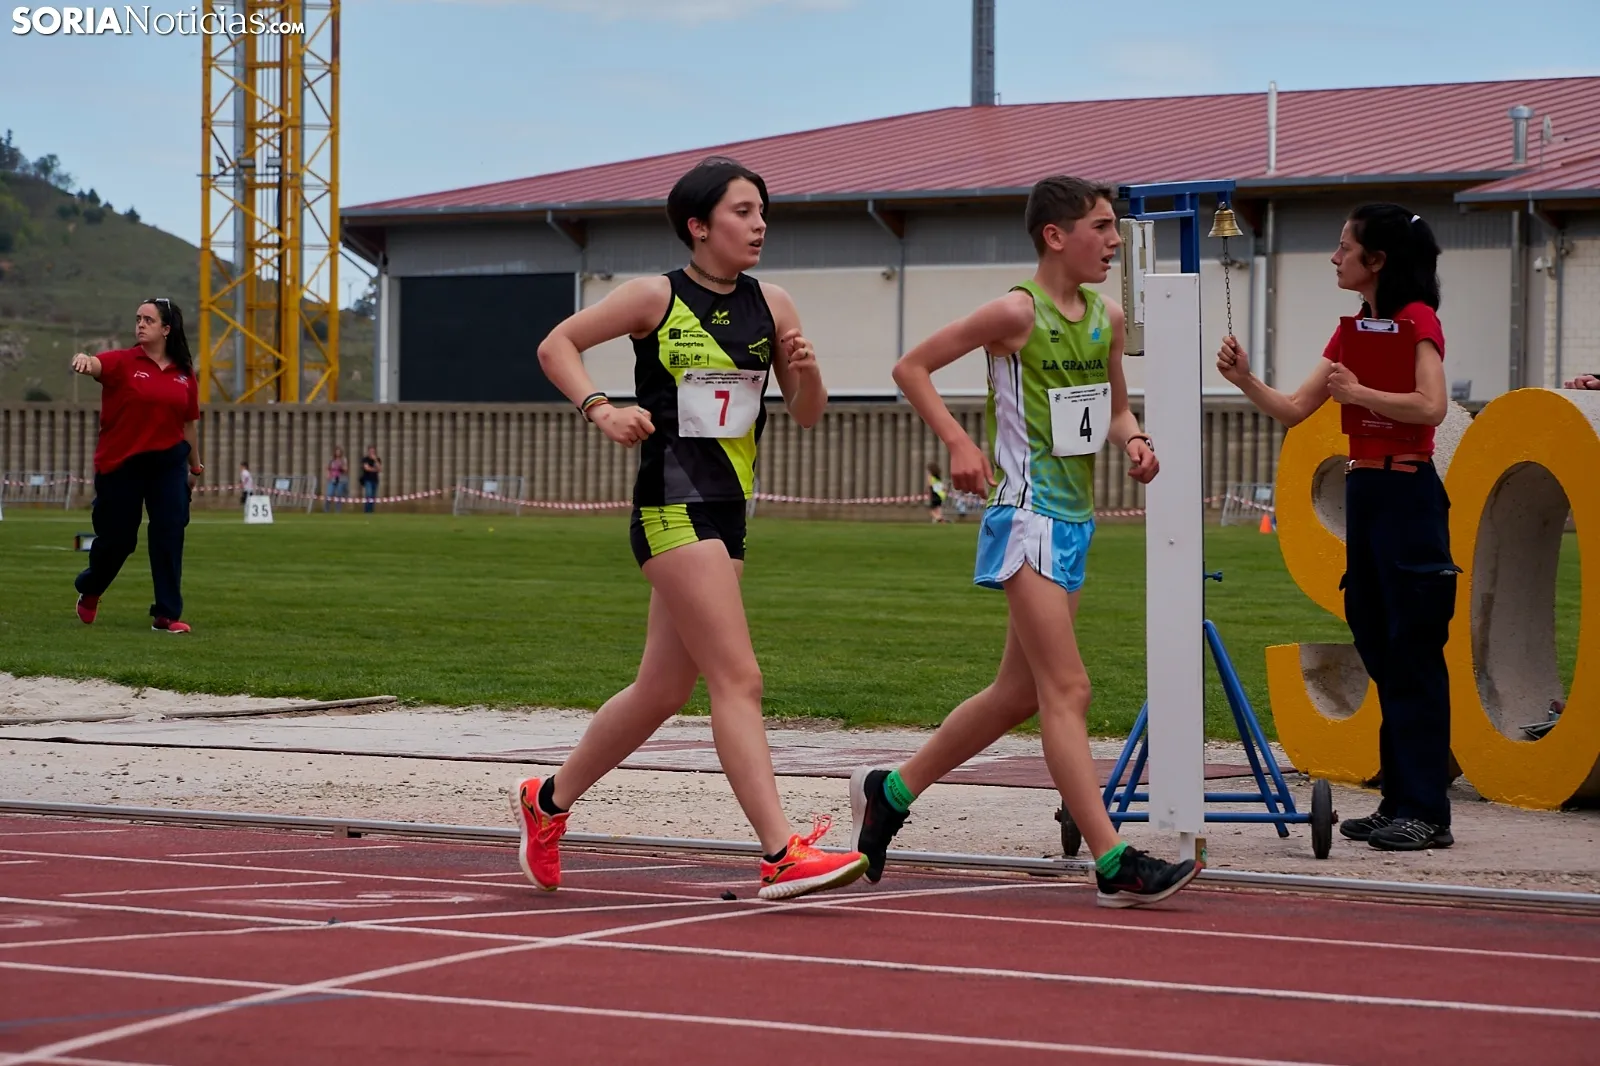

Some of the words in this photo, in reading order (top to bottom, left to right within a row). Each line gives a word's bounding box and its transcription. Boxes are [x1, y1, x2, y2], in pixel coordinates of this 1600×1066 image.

[1042, 360, 1060, 371] LA
[1061, 359, 1104, 371] GRANJA
[714, 390, 730, 427] 7
[1079, 406, 1093, 443] 4
[252, 503, 269, 518] 35
